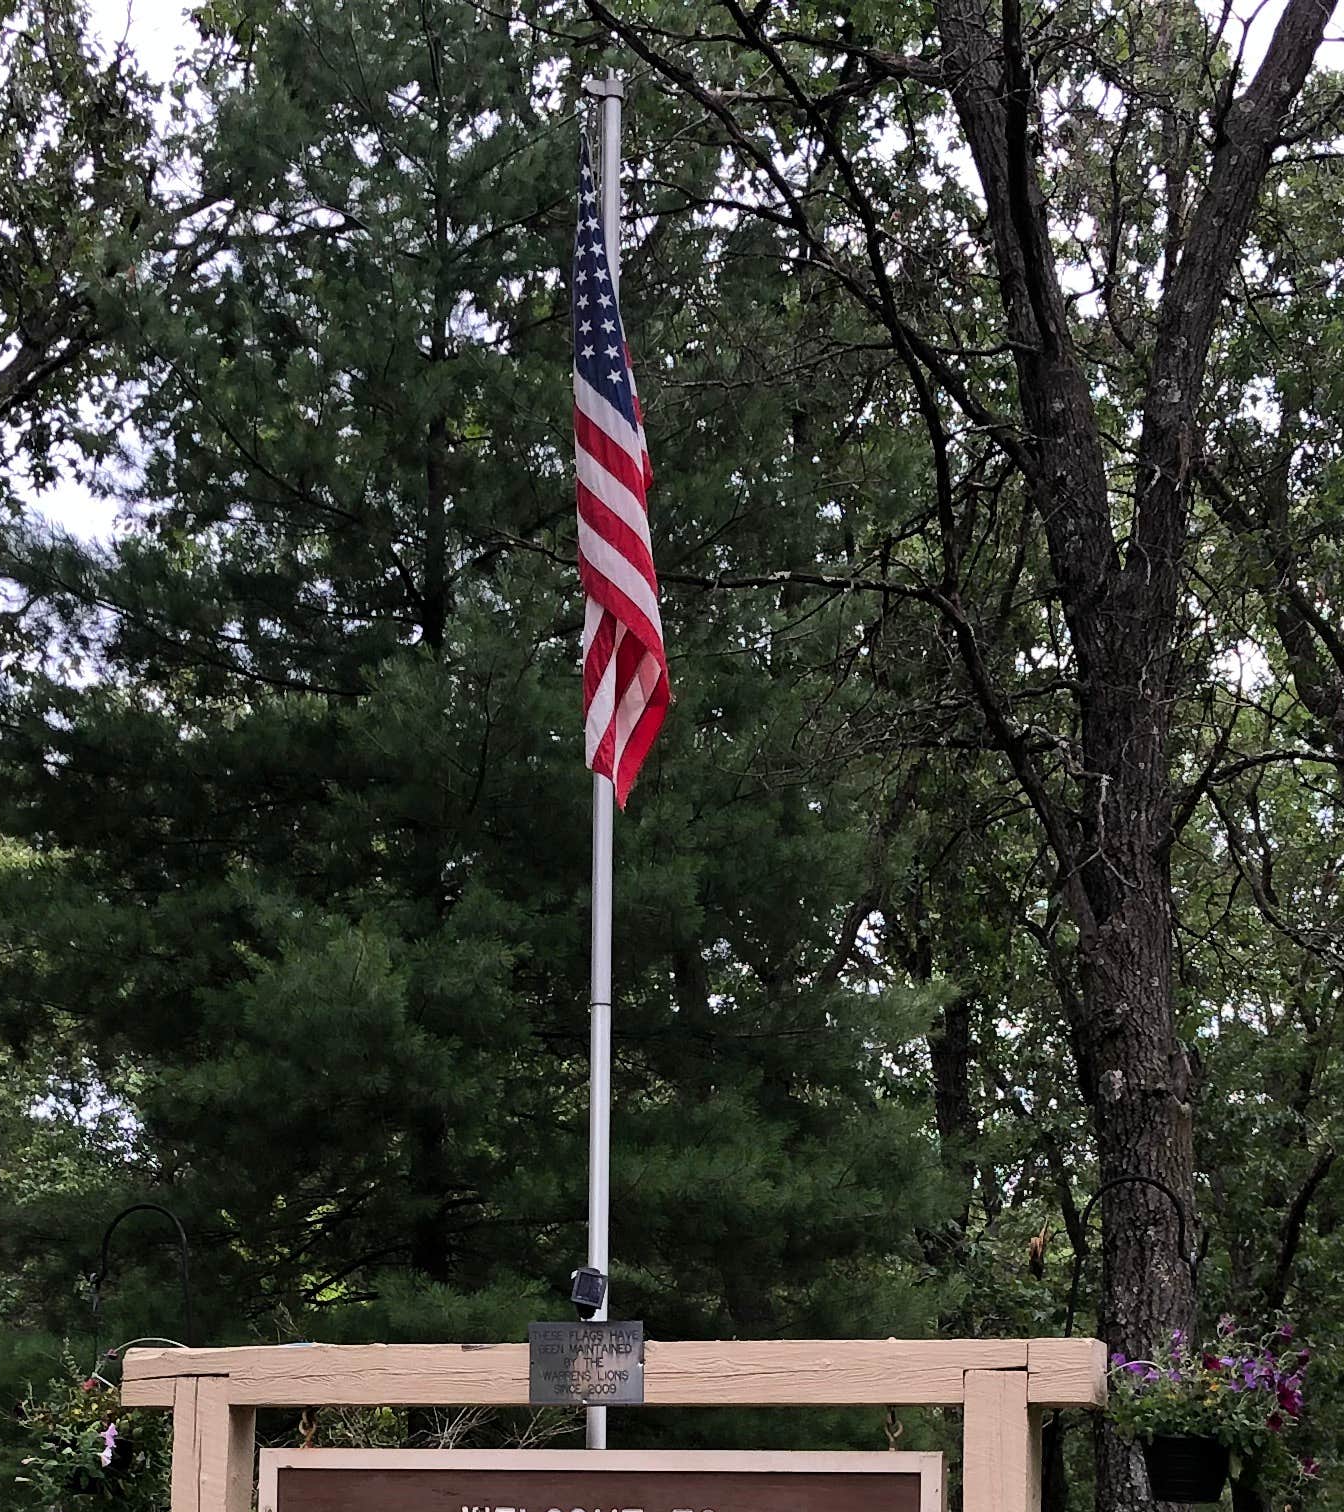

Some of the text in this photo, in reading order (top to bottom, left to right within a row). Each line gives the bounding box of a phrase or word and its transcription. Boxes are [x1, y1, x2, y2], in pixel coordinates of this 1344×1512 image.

[533, 1330, 639, 1341] THESE FLAGS HAVE
[539, 1343, 632, 1354] BEEN MAINTAINED
[564, 1357, 604, 1368] BY THE
[542, 1370, 629, 1381] WARRENS LIONS
[554, 1383, 616, 1394] SINCE 2009
